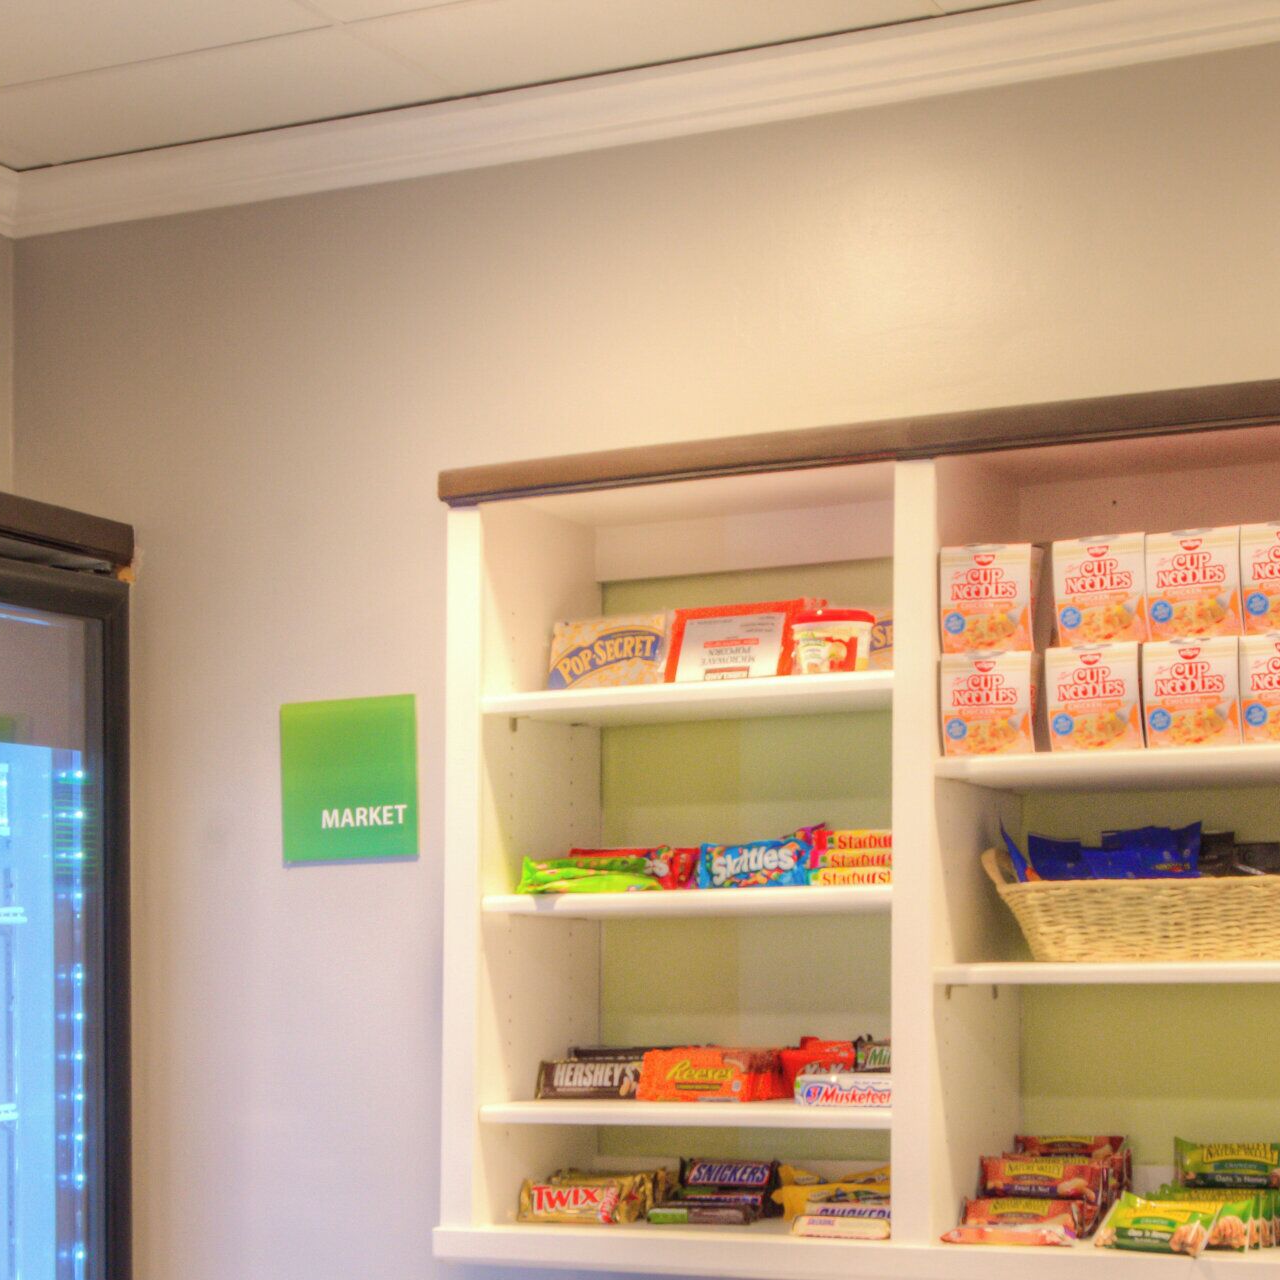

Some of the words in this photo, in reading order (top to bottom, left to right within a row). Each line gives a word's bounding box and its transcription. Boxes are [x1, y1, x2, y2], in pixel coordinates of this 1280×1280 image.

[1080, 559, 1118, 576] CUP
[1172, 552, 1211, 569] CUP
[966, 568, 1003, 583] CUP
[1065, 571, 1132, 594] NOODLES
[1157, 565, 1225, 588] NOODLES
[951, 582, 1017, 601] NOODLES
[1073, 667, 1111, 683] CUP
[1171, 662, 1210, 678] CUP
[966, 674, 1004, 690] CUP
[1057, 679, 1125, 702] NOODLES
[1155, 675, 1225, 696] NOODLES
[952, 688, 1017, 706] NOODLES
[321, 804, 408, 829] MARKET
[713, 845, 795, 886] Skittles
[553, 1062, 635, 1088] HERSHEY'S
[807, 1087, 819, 1101] 3
[693, 1163, 768, 1183] SNICKERS
[1215, 1175, 1232, 1183] Oats
[1243, 1176, 1268, 1185] Honey
[532, 1185, 600, 1211] TWIX
